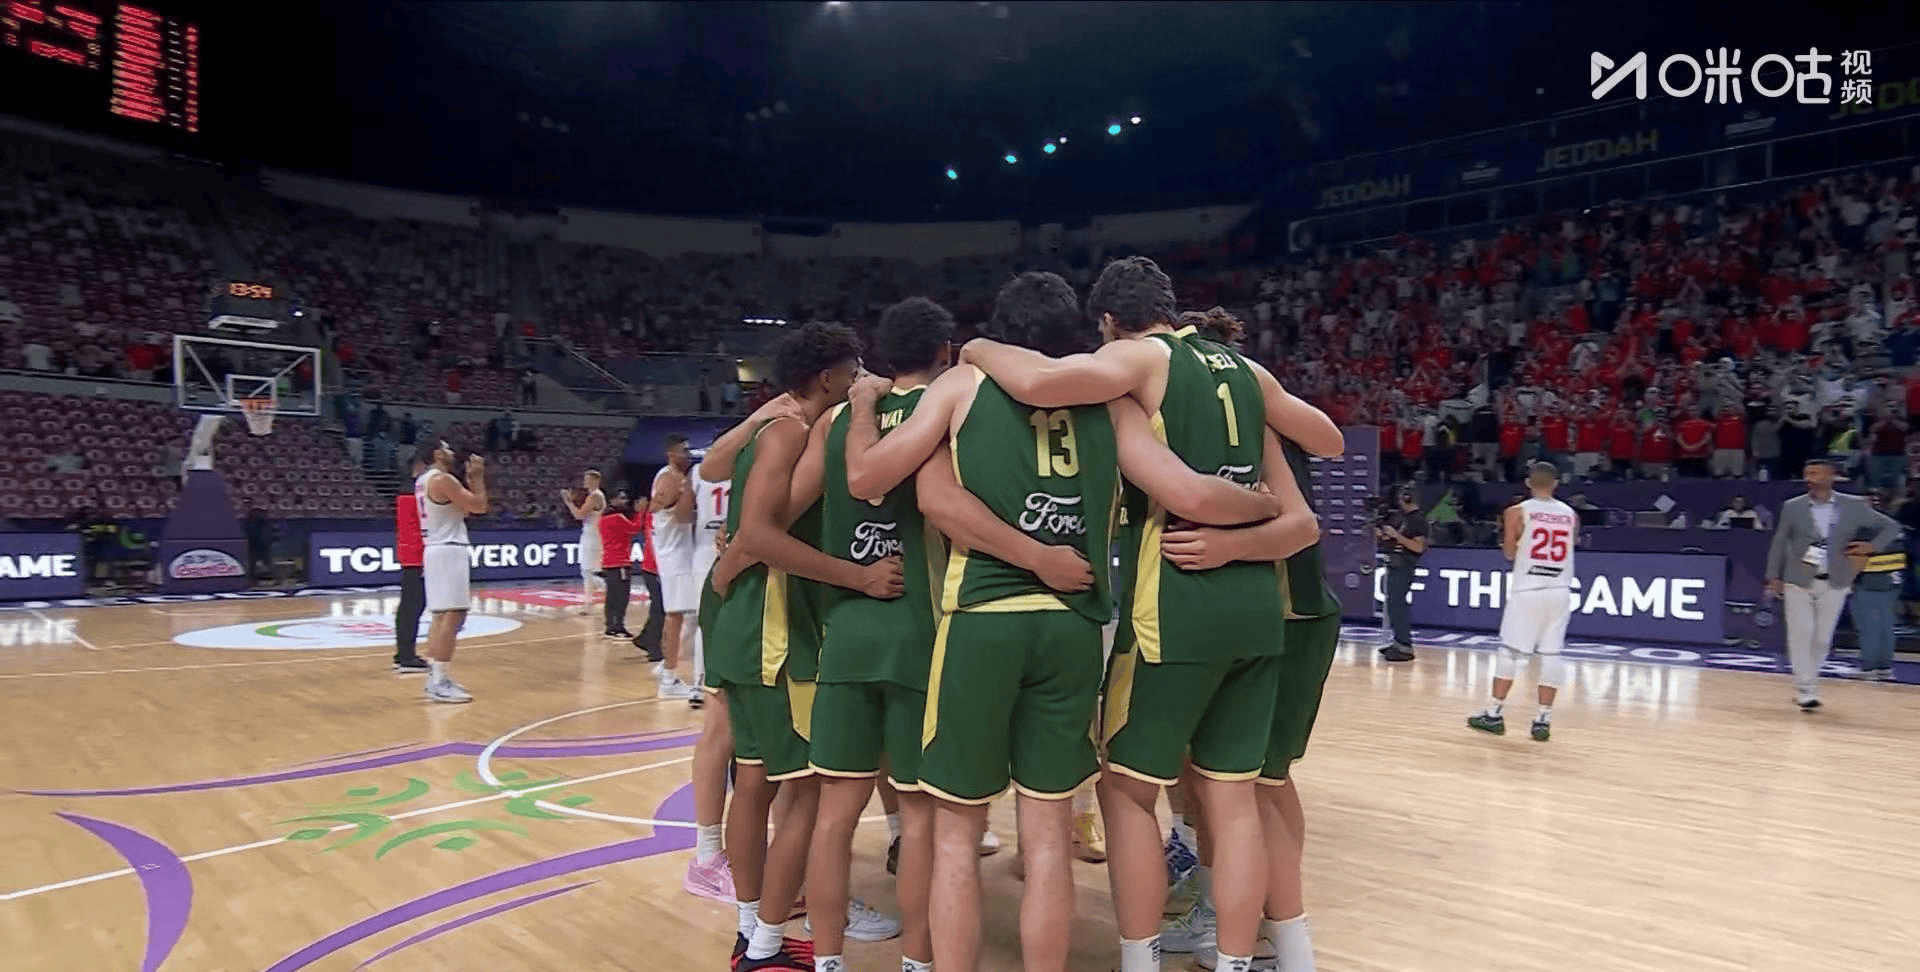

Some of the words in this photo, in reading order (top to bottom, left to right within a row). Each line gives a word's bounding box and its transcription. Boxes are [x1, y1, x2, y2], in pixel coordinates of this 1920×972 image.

[1535, 127, 1660, 173] JEDDAH
[1216, 382, 1240, 447] 1
[1030, 409, 1080, 478] 13
[320, 546, 402, 573] TCL
[524, 543, 558, 567] OF
[1531, 527, 1569, 562] 25
